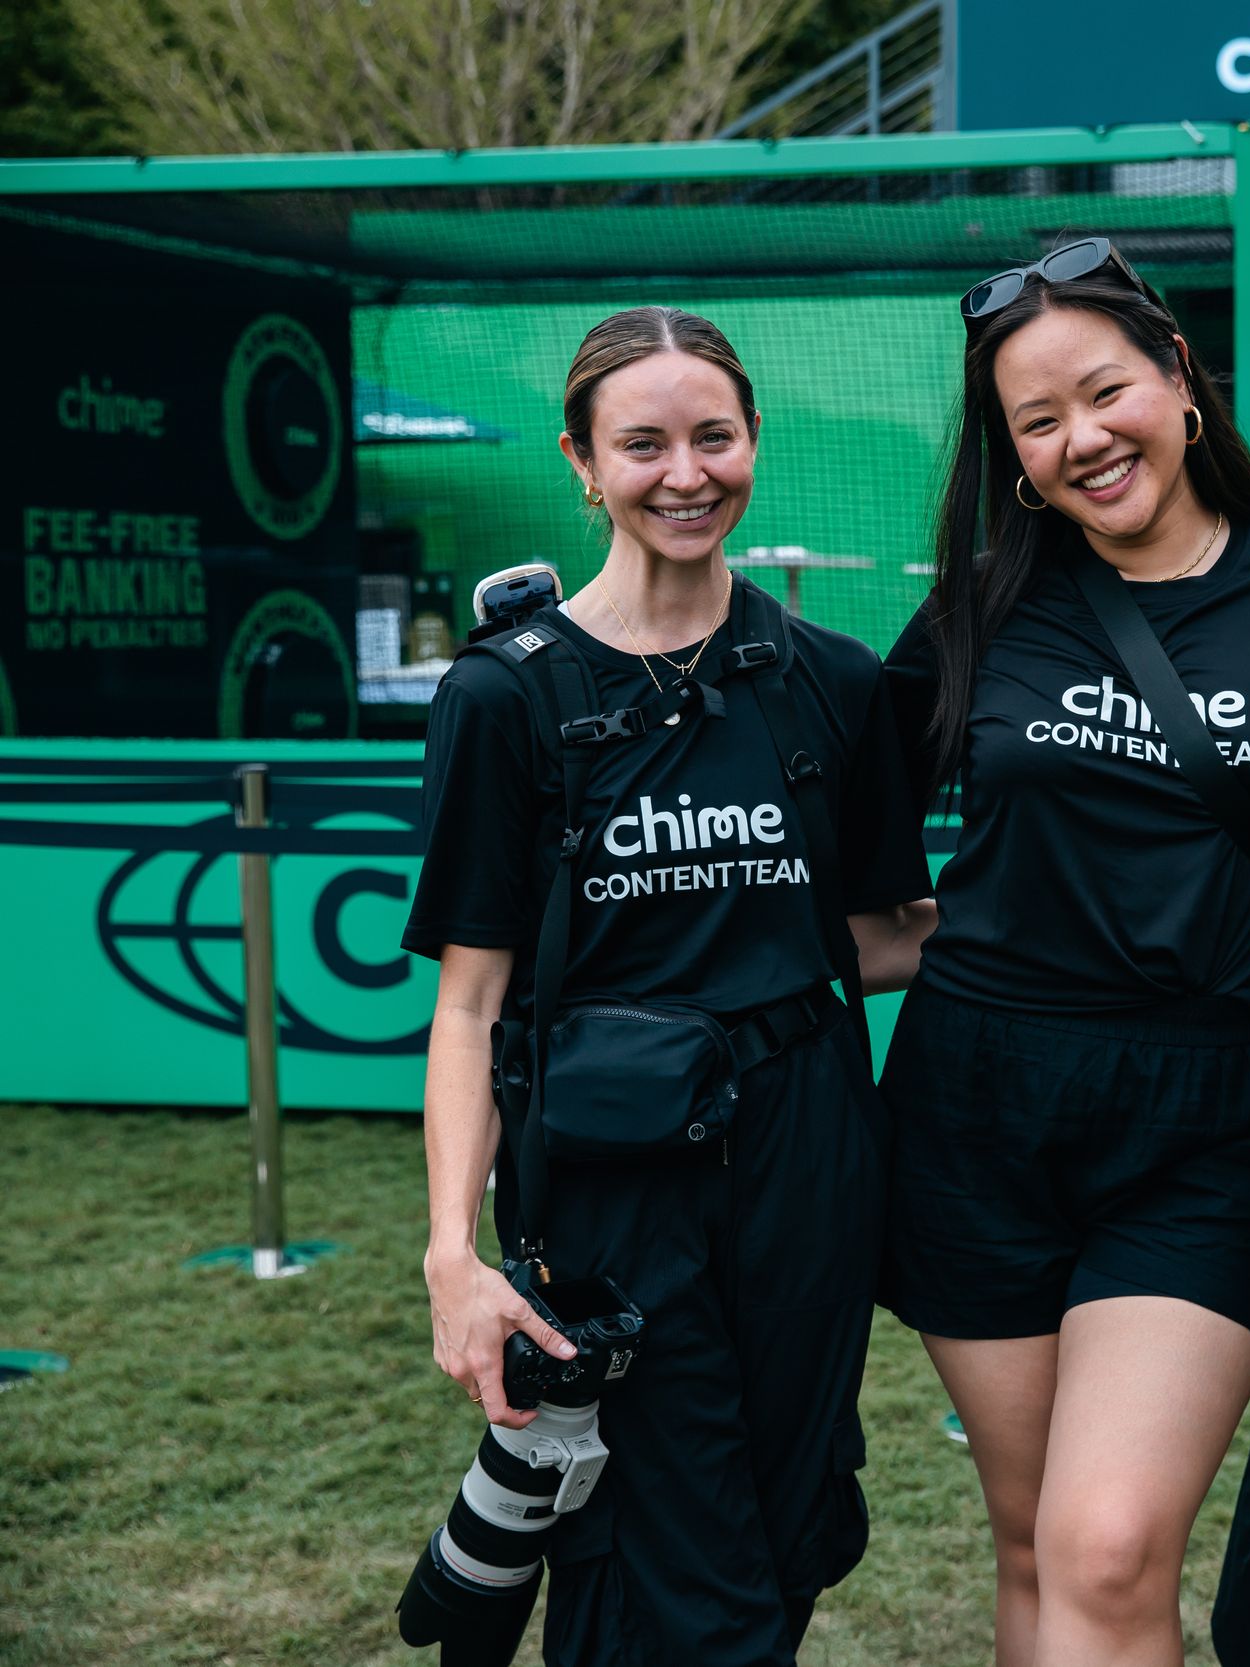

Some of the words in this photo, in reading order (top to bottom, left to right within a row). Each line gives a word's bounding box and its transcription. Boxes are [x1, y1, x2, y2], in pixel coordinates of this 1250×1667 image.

[57, 372, 165, 439] chime
[24, 507, 201, 556] FEE-FREE
[25, 556, 207, 616] BANKING
[1062, 676, 1247, 733] chie
[1026, 720, 1180, 768] CONTEN
[603, 794, 786, 857] chime
[583, 861, 735, 903] CONTENT
